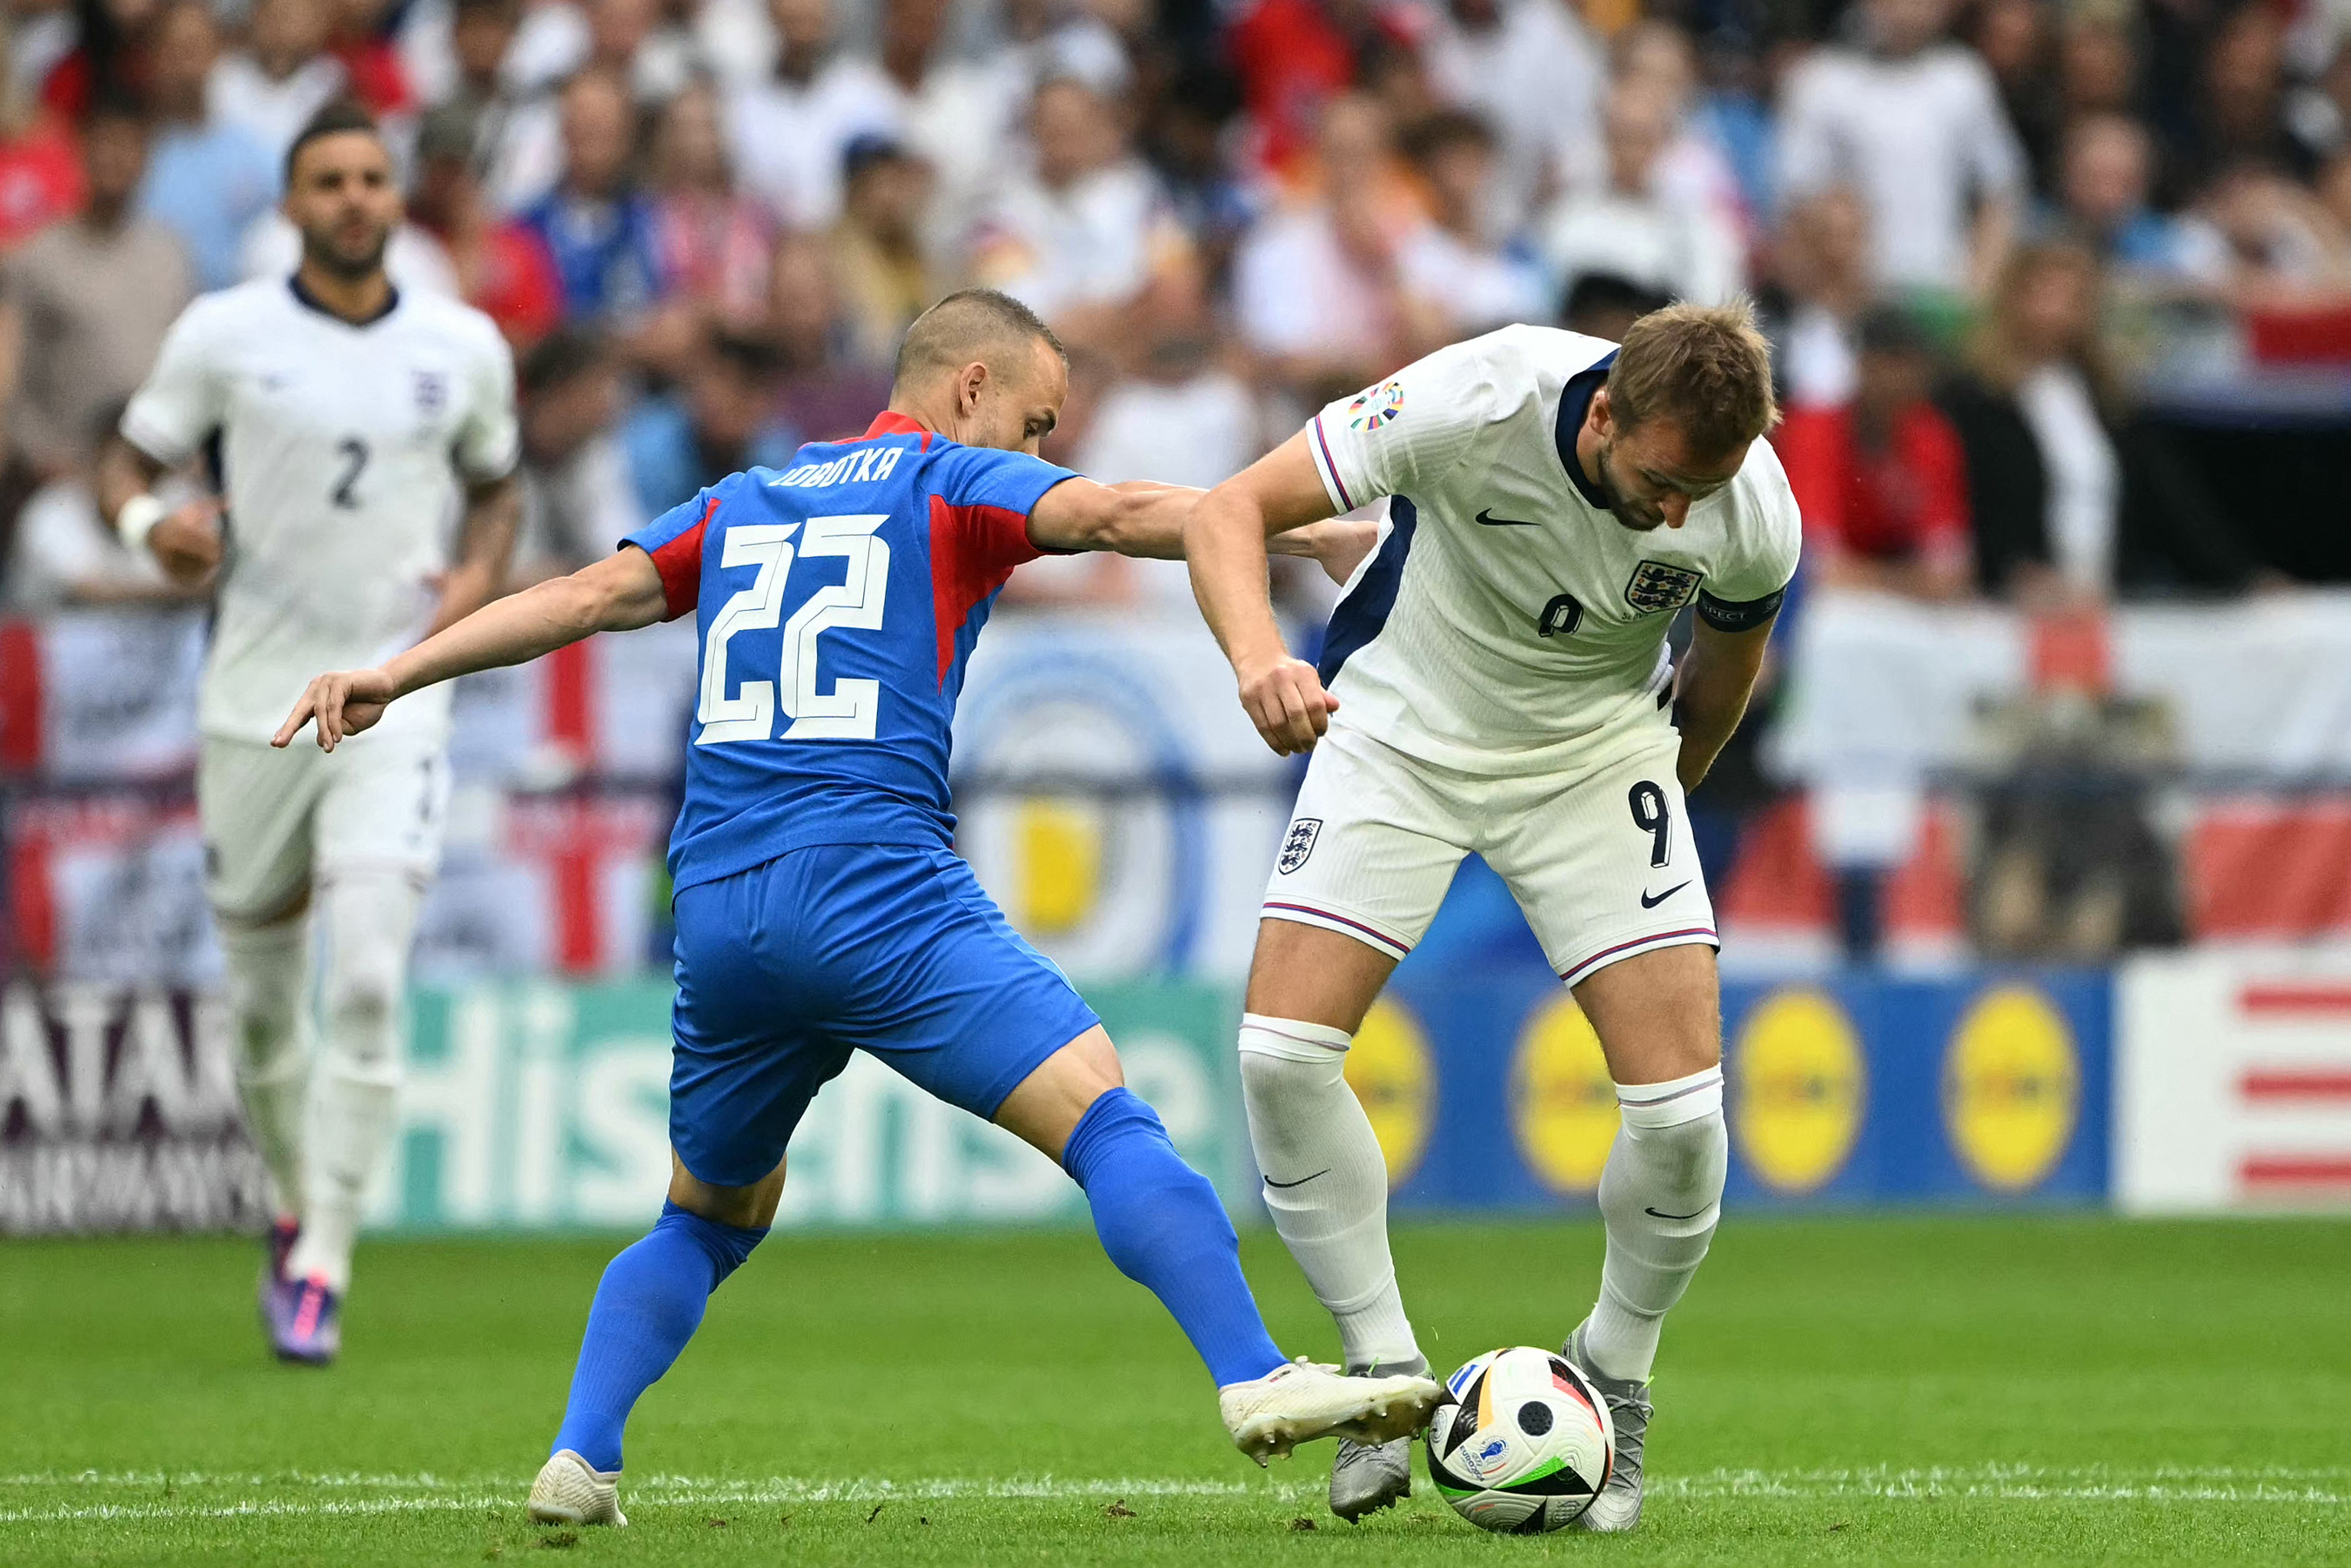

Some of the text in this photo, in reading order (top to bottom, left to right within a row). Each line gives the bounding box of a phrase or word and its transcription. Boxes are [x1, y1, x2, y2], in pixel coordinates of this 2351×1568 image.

[331, 437, 369, 510] 2
[694, 514, 890, 746] 22
[1705, 605, 1747, 620] PECT
[1628, 780, 1673, 868] 9
